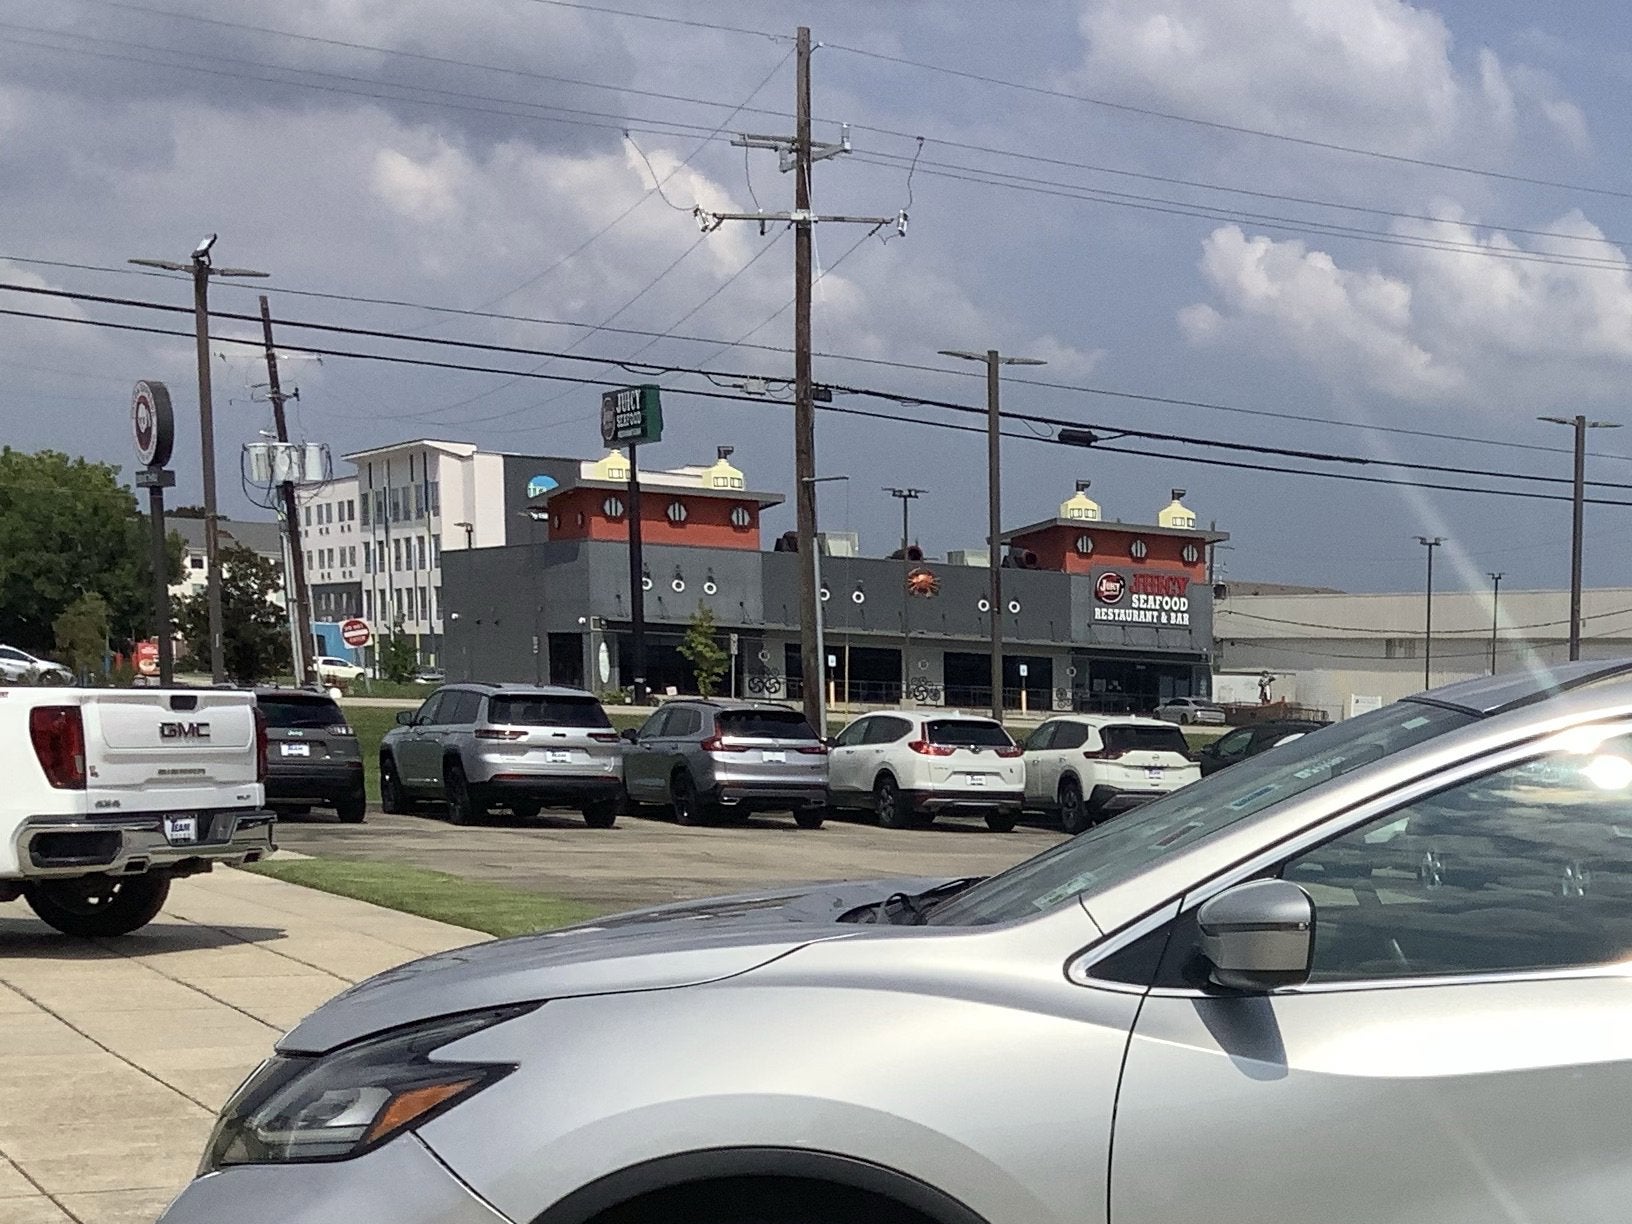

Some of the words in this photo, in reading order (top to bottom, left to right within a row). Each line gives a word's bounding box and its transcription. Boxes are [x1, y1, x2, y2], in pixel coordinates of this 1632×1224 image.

[616, 389, 641, 413] JUICY
[1131, 594, 1189, 612] SEAFOOD
[1094, 607, 1159, 624] RESTAURANT
[1160, 610, 1168, 624] &
[1170, 612, 1190, 626] BAR
[160, 722, 211, 739] GMC
